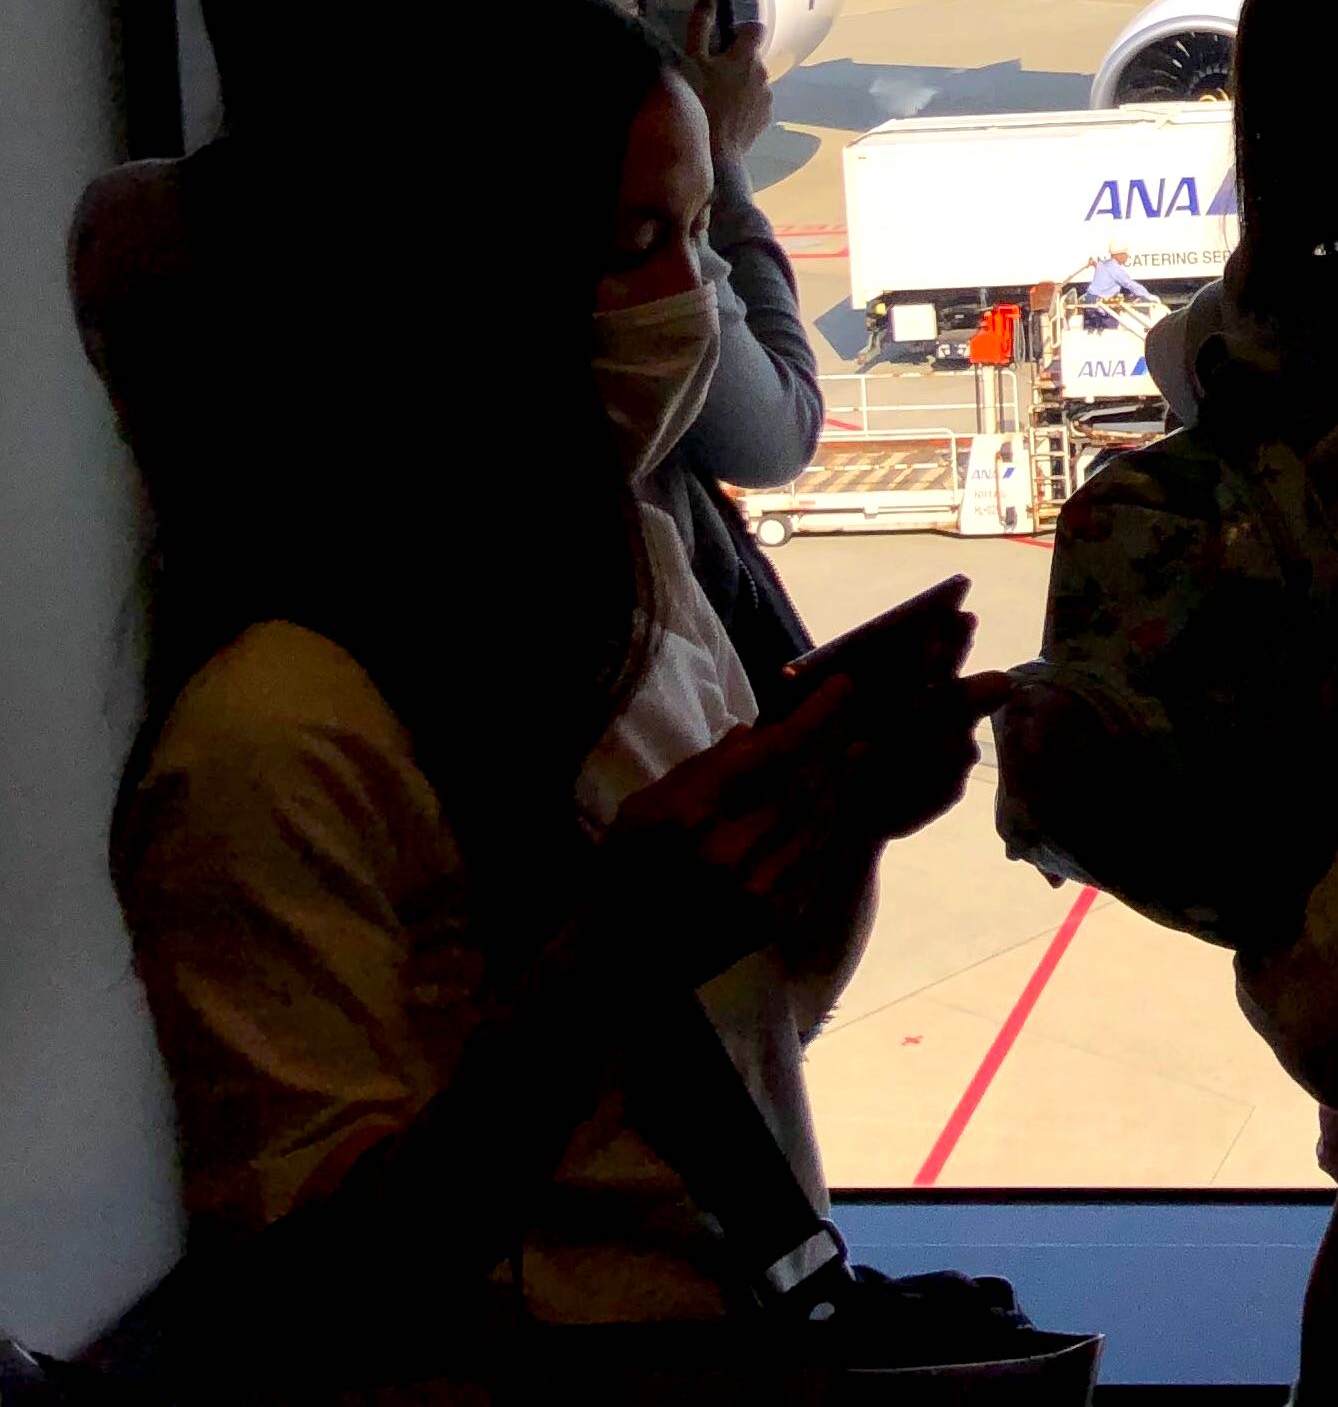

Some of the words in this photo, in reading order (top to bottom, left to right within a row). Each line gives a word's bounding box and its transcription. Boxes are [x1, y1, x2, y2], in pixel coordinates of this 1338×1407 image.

[1084, 177, 1201, 221] ANA
[1124, 251, 1198, 268] CATERING
[1077, 360, 1126, 378] ANA
